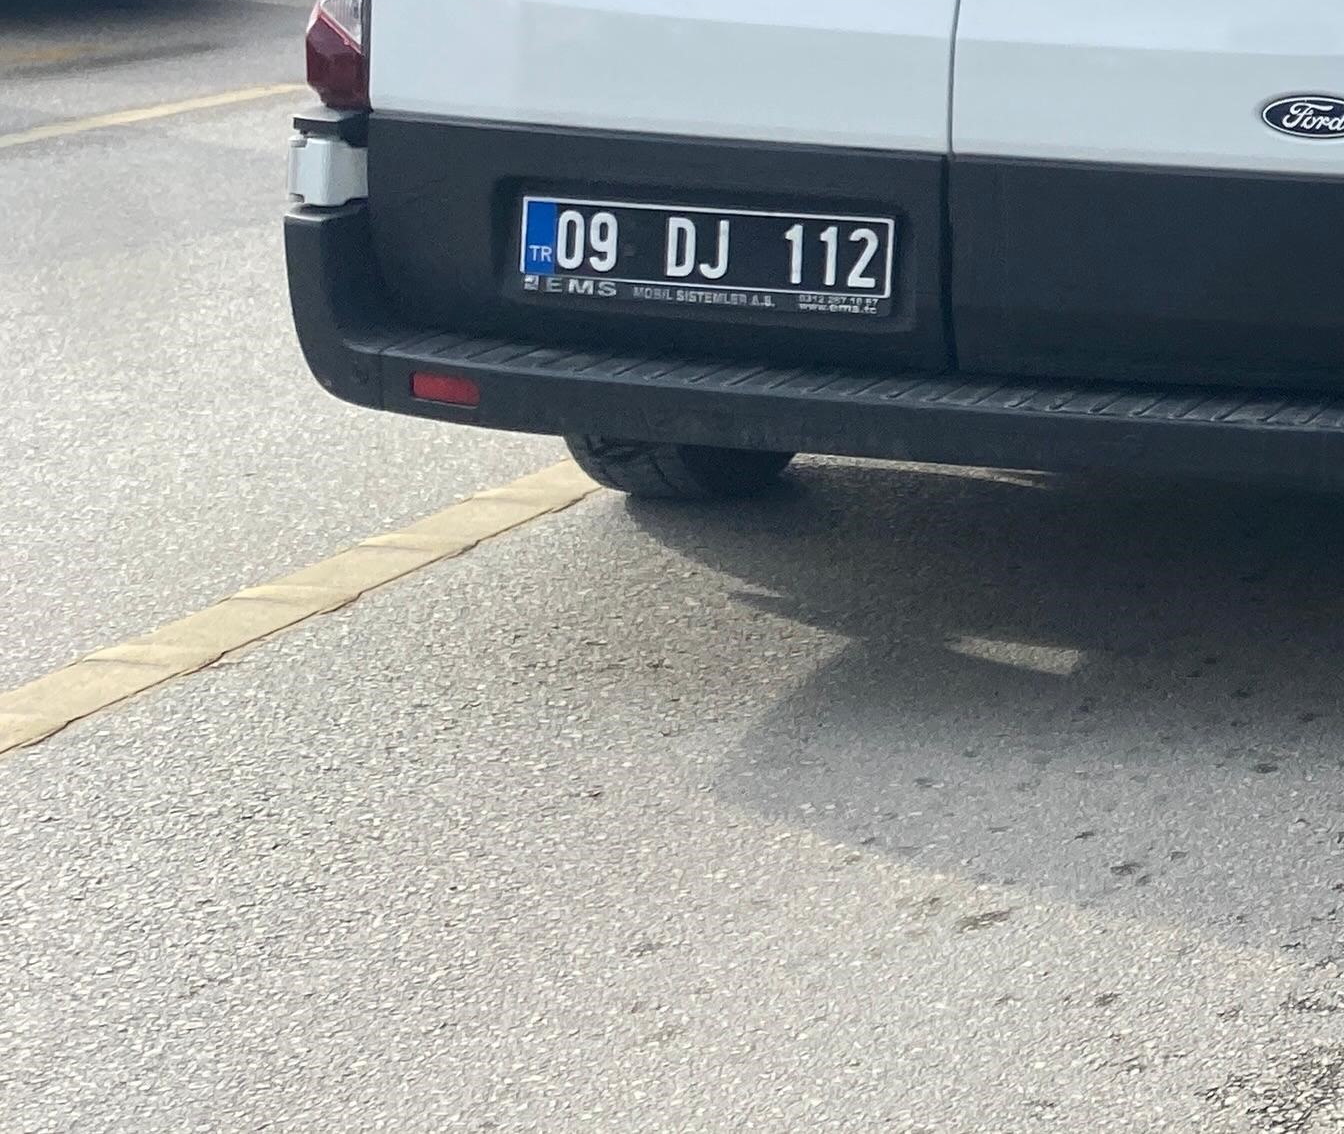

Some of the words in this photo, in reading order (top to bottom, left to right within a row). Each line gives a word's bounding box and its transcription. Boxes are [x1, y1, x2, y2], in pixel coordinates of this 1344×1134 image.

[528, 244, 553, 263] TR
[556, 209, 618, 272] 09
[666, 216, 730, 280] DJ
[785, 222, 879, 289] 112
[545, 276, 617, 297] EMS
